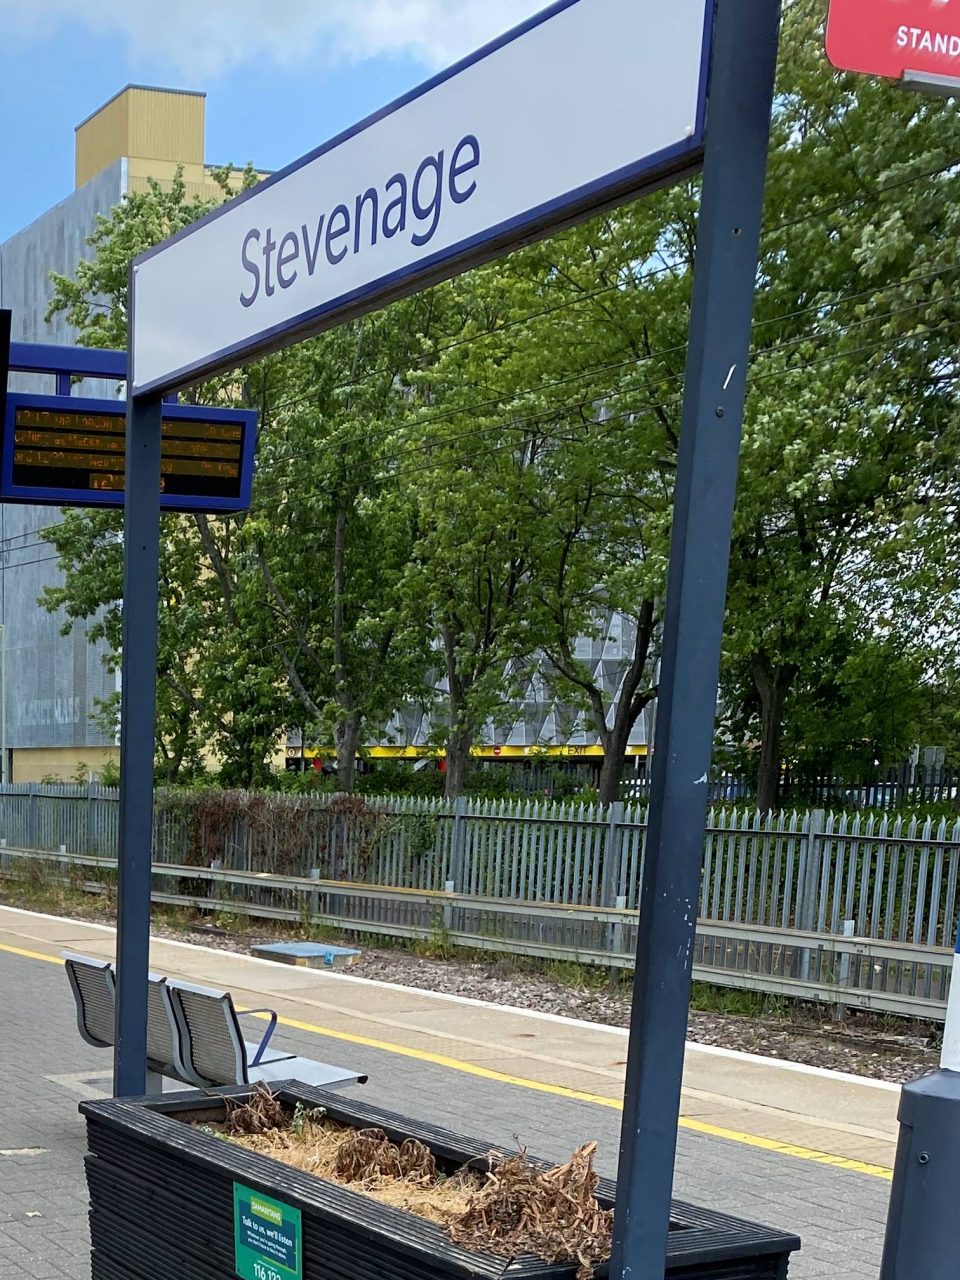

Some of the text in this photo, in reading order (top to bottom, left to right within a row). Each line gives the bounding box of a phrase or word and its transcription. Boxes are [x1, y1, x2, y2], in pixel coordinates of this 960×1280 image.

[896, 25, 960, 56] STAND
[240, 134, 481, 308] Stevenage
[567, 745, 588, 755] EXIT
[242, 1215, 253, 1228] Talk
[252, 1221, 259, 1231] to
[278, 1232, 293, 1247] listen
[253, 1263, 266, 1280] 116
